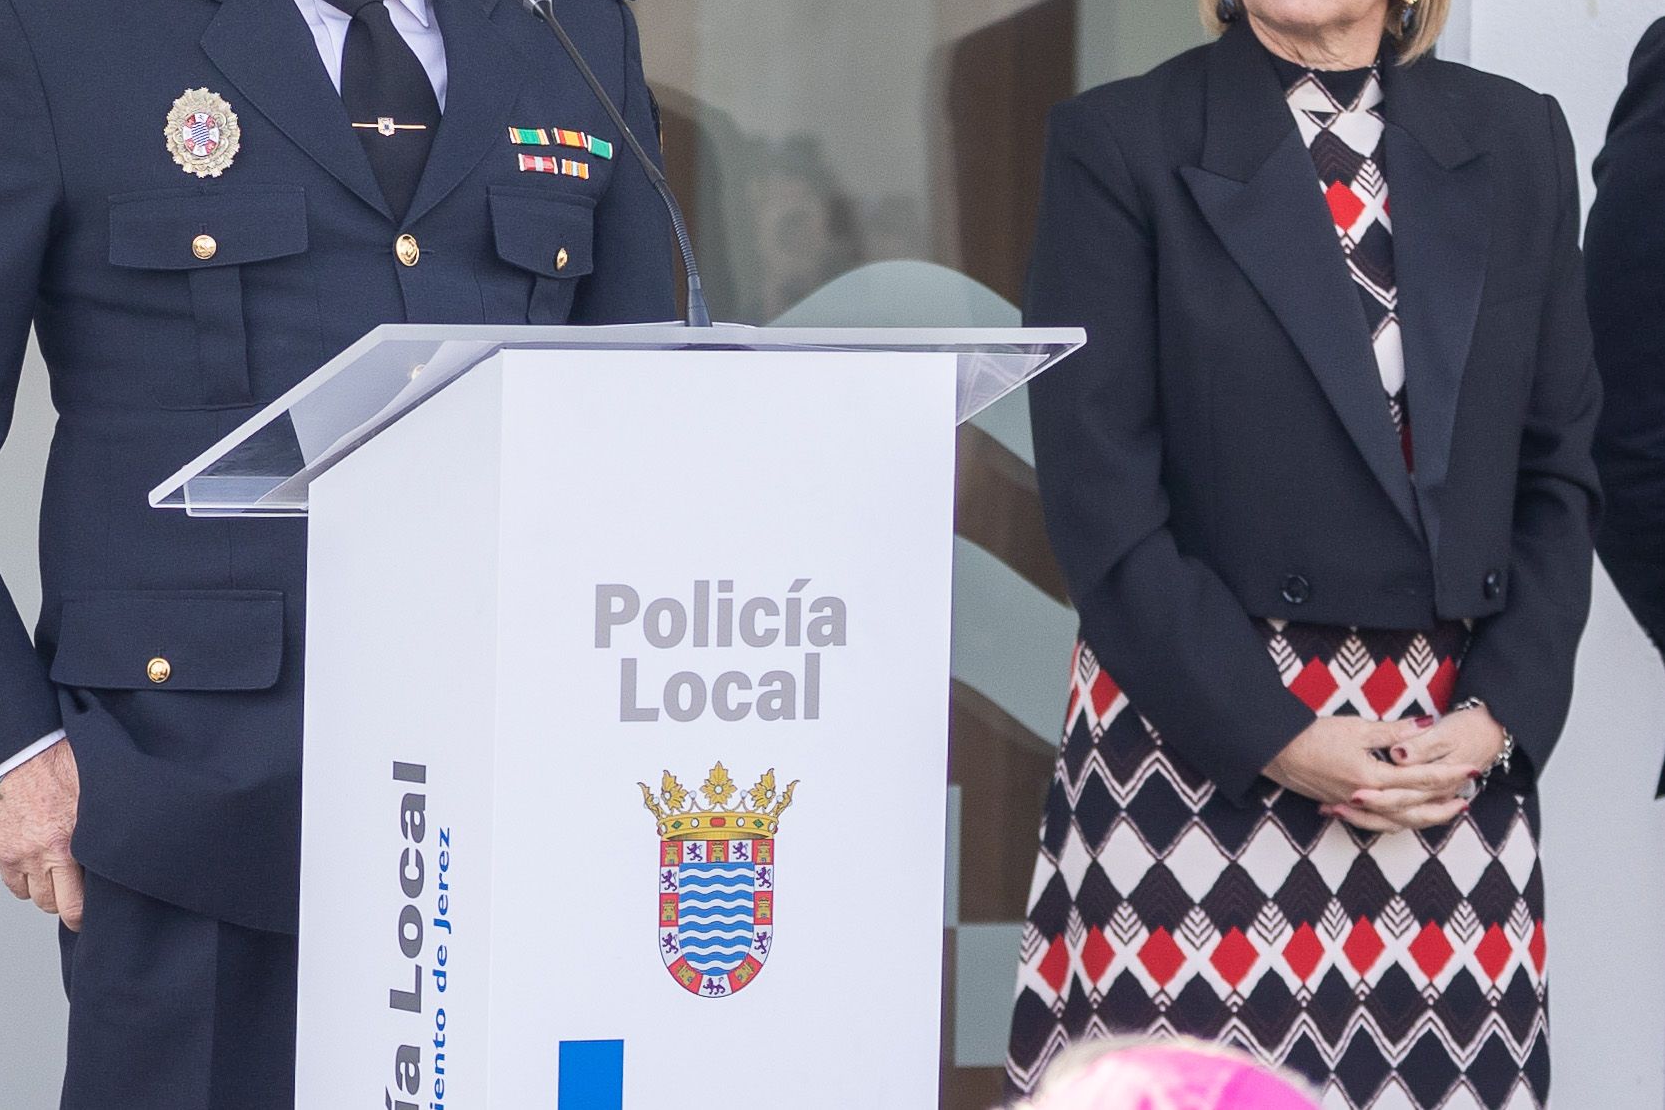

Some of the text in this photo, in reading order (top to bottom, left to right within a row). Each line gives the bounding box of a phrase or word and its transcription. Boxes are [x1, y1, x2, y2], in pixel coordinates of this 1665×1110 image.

[594, 578, 847, 649] Policía
[619, 652, 821, 722] Local
[389, 760, 426, 1014] Local
[433, 826, 452, 935] Jerez
[432, 944, 448, 993] de
